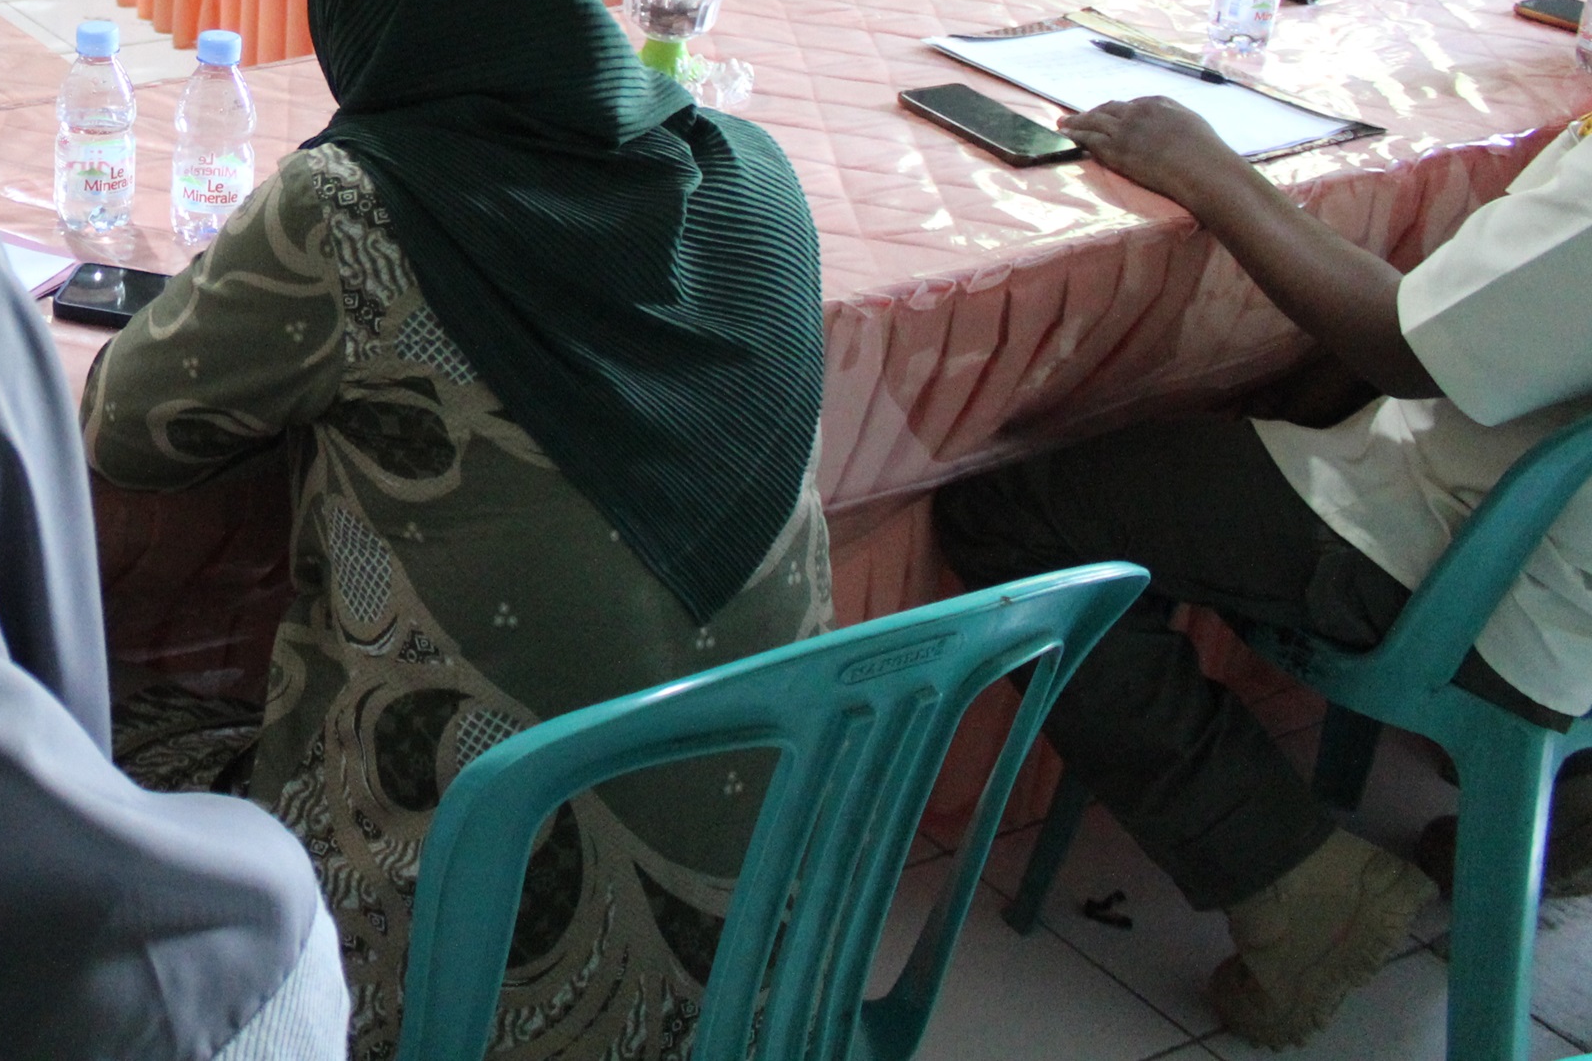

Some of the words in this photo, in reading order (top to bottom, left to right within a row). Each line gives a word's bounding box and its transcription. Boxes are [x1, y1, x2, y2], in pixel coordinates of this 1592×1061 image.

[110, 166, 124, 180] Le
[207, 179, 224, 193] Le
[182, 187, 238, 204] Minerale
